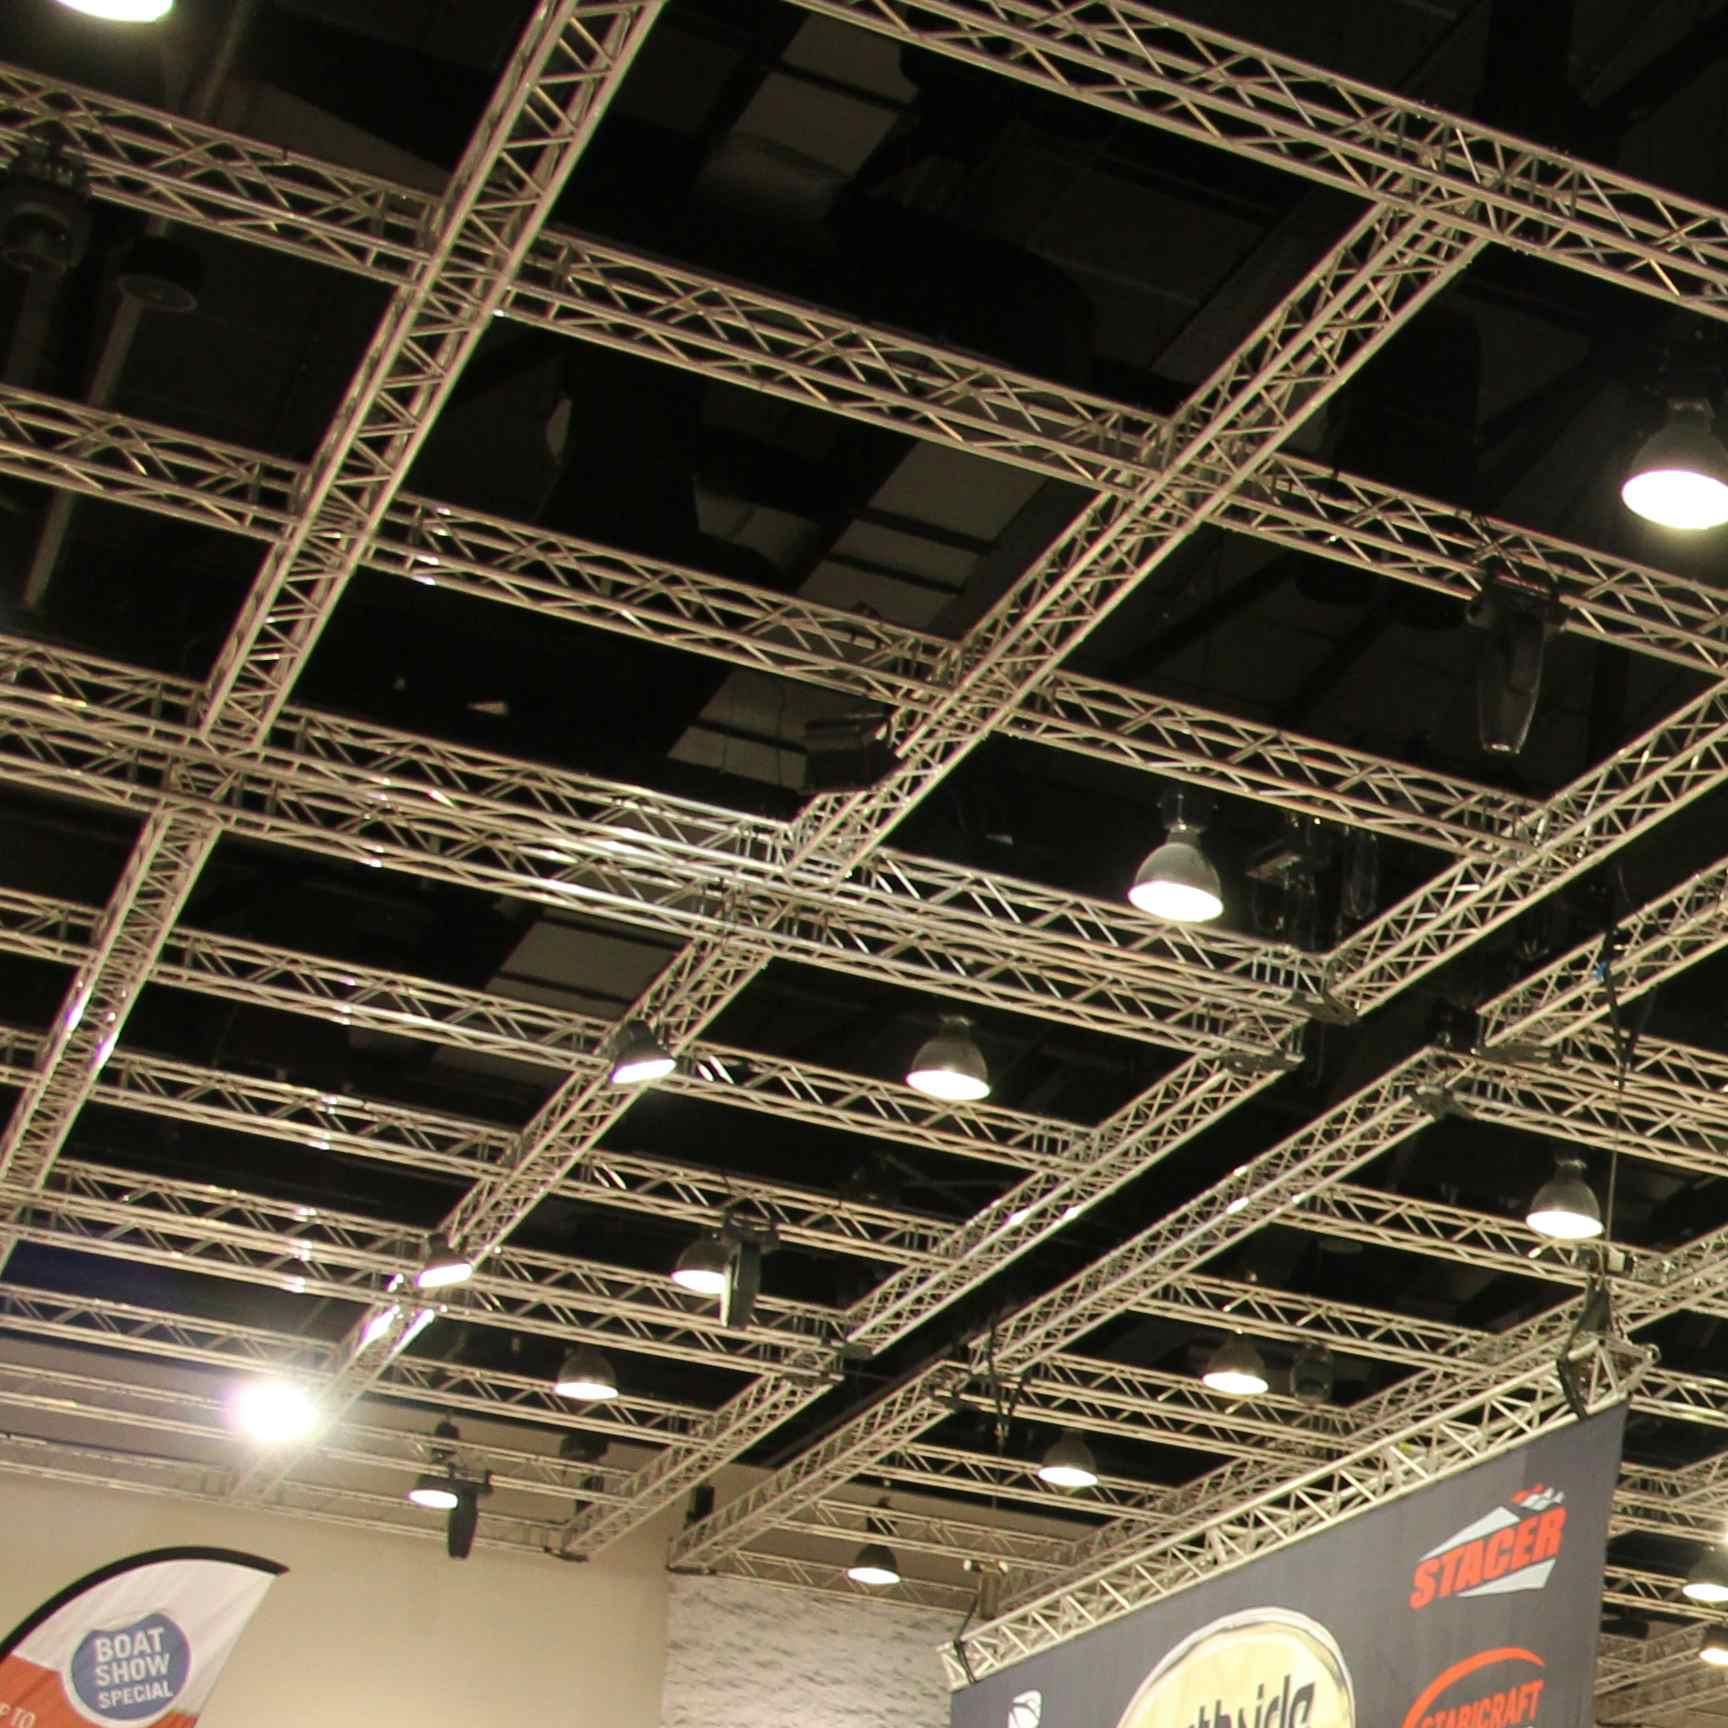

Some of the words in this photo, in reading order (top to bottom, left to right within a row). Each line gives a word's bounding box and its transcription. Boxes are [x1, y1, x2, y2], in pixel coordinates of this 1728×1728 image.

[1409, 1506, 1567, 1609] STACER
[95, 1627, 164, 1663] BOAT
[95, 1653, 171, 1686] SHOW
[98, 1681, 174, 1709] SPECIAL
